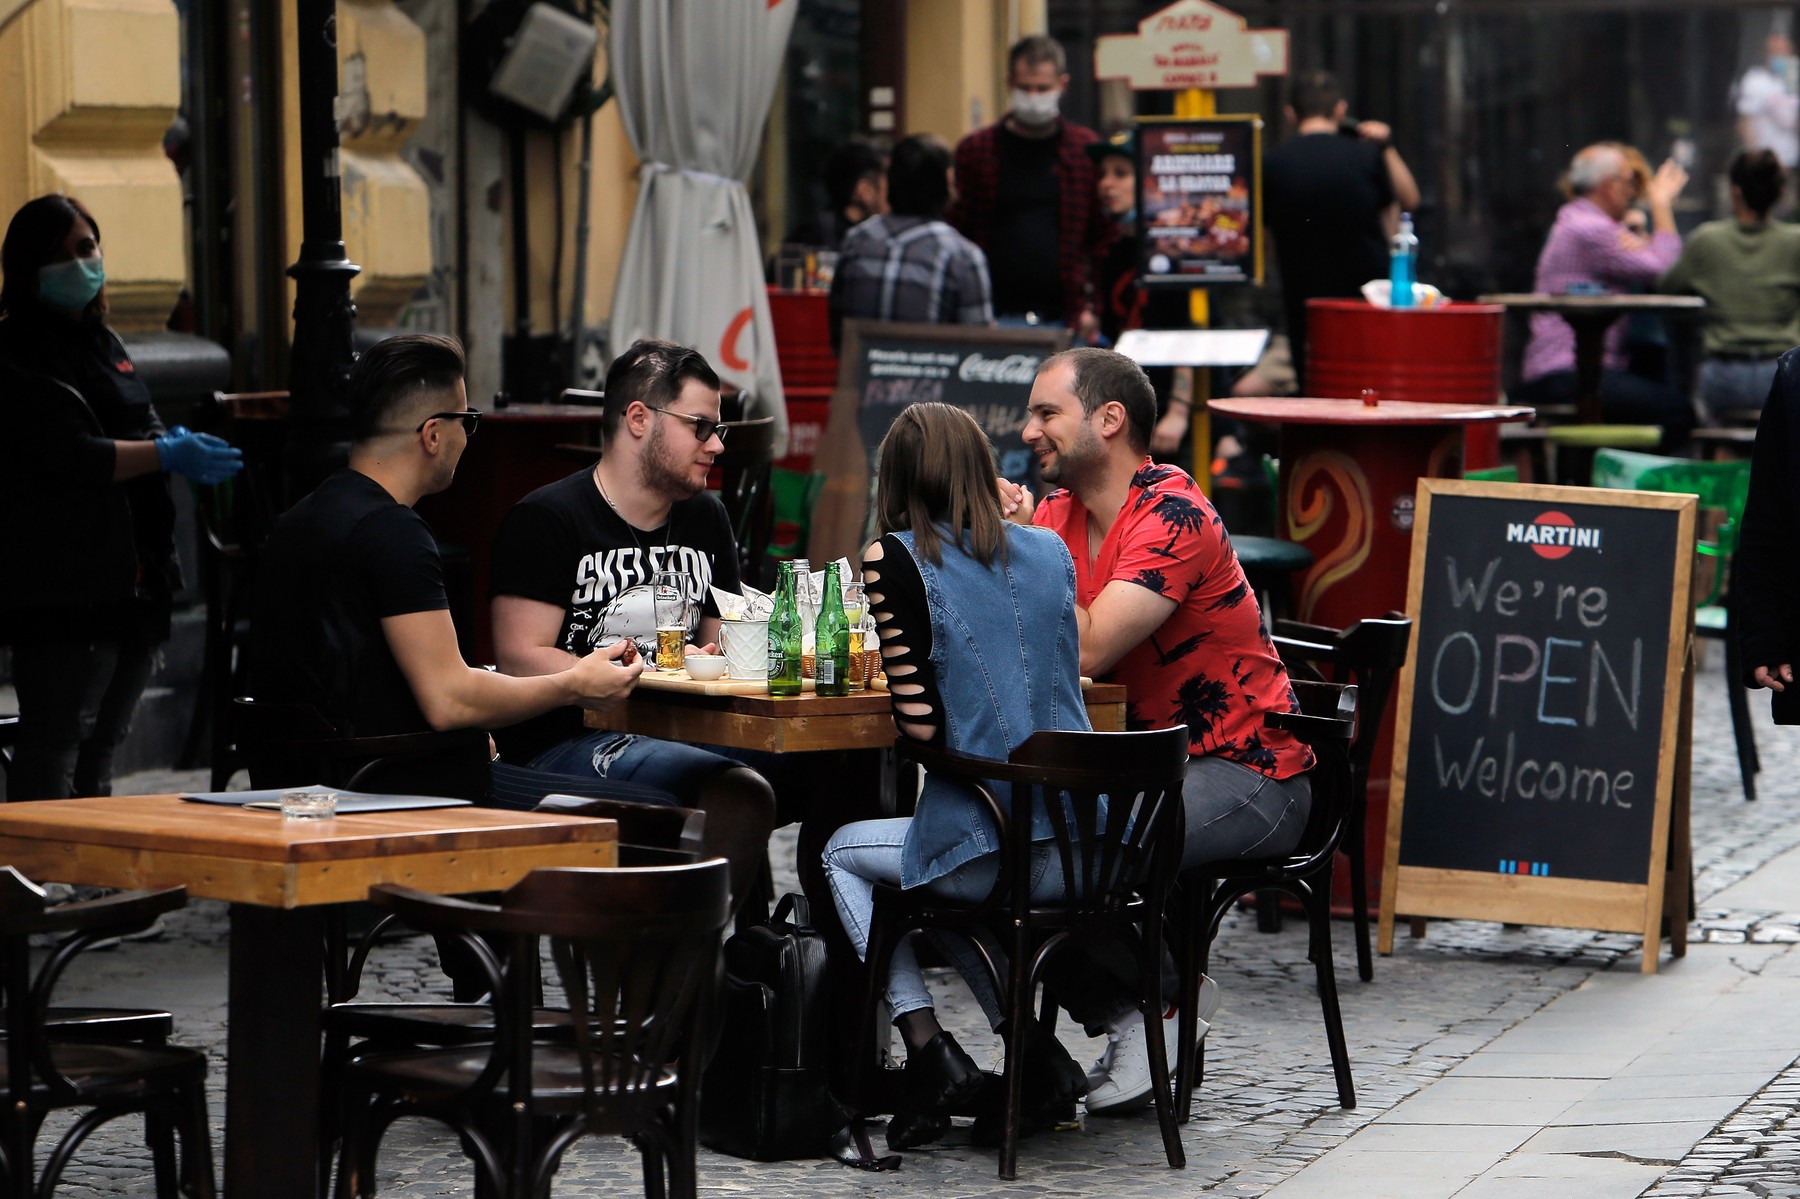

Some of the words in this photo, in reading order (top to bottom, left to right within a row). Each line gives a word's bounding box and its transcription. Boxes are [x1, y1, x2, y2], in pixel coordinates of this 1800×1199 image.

[1506, 523, 1600, 548] MARTINI
[572, 545, 715, 604] SKELETON
[1446, 556, 1608, 628] We're
[1432, 631, 1643, 731] OPEN
[1434, 731, 1634, 809] Welcome
